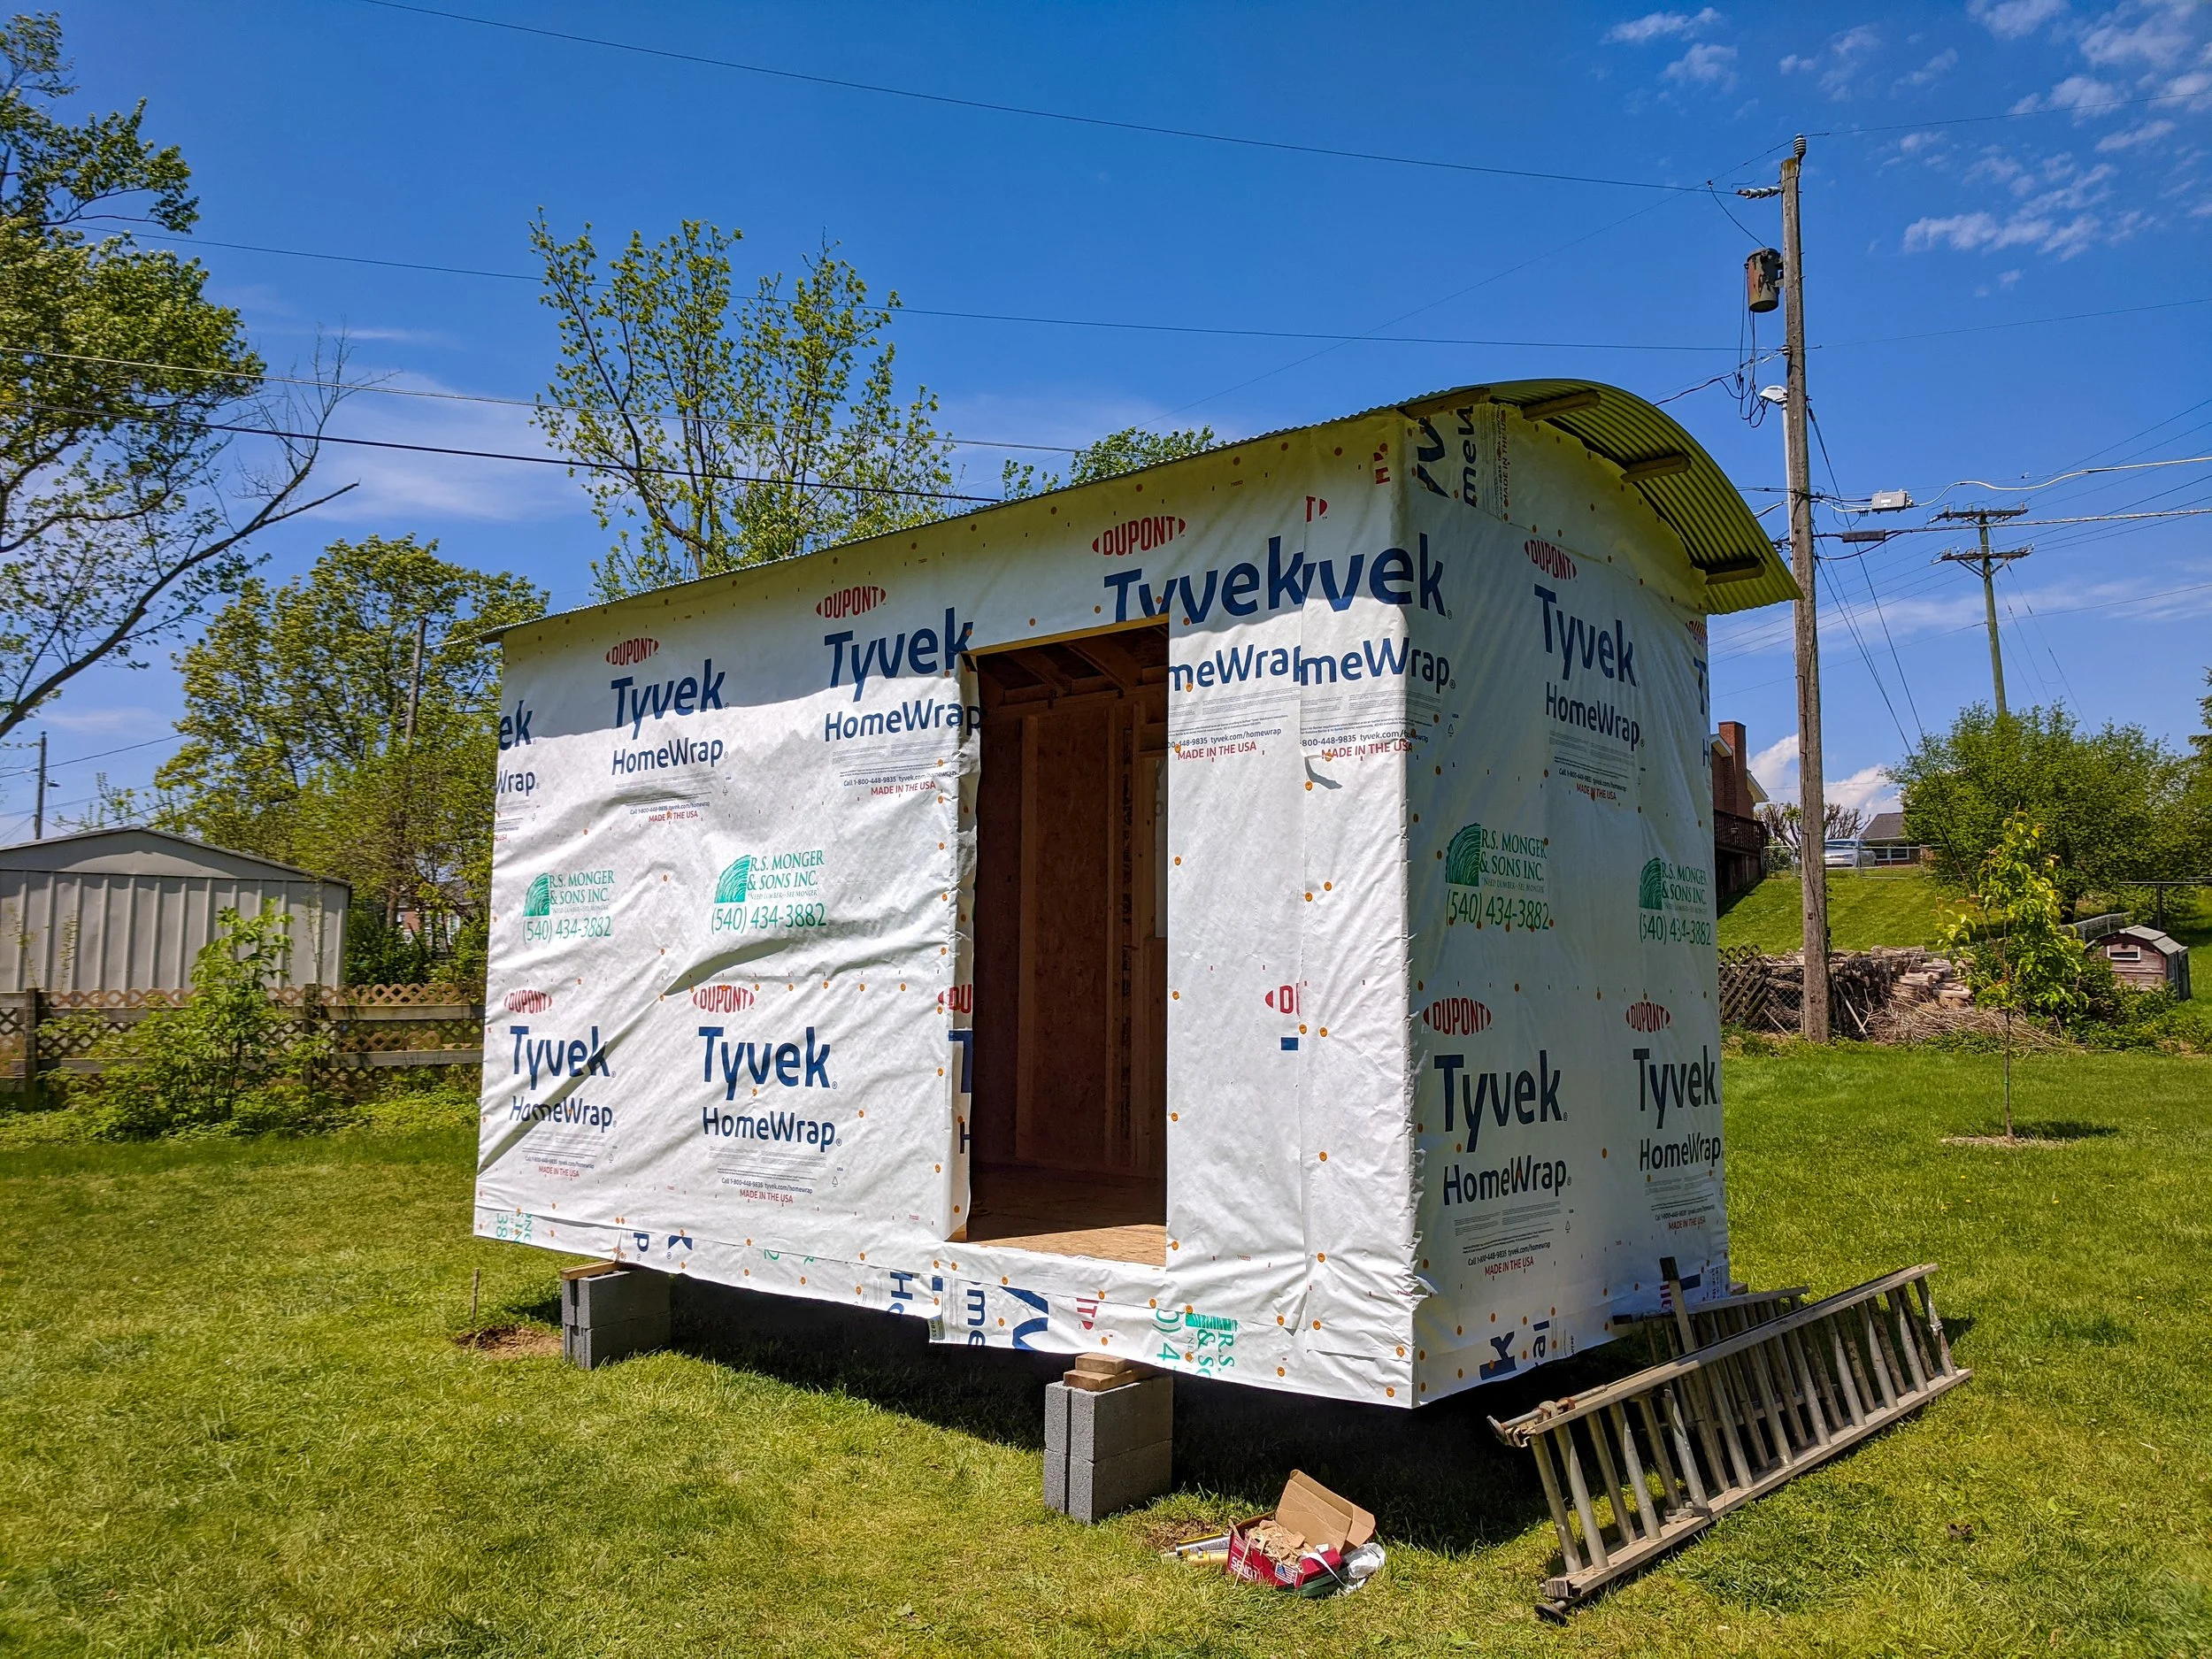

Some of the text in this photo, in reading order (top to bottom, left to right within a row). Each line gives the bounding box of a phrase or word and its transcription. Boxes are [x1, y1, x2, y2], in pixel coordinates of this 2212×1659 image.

[1102, 516, 1175, 557] DUPONT
[1530, 540, 1572, 580] DUPONT
[824, 586, 879, 618] DUPONT
[611, 637, 654, 665] DUPONT
[1533, 583, 1637, 687] Tyvek
[824, 607, 978, 702] Tyvek
[611, 658, 726, 740] Tyvek
[1693, 657, 1709, 715] T
[825, 698, 981, 741] HomeWrap
[1546, 681, 1640, 751] HomeWrap
[1178, 741, 1256, 760] MADE IN THE USA
[1210, 728, 1281, 744] tyvek.com/homewrap
[1355, 745, 1365, 756] IN
[1368, 742, 1390, 754] THE
[611, 737, 724, 775] HomeWrap
[854, 776, 896, 786] 1-800-448-9835
[871, 780, 936, 795] MADE IN THE USA
[1481, 828, 1548, 859] R.S. MONGER
[749, 849, 825, 872] R.S. MONGER
[1479, 851, 1544, 881] & SONS INC.
[1661, 862, 1675, 879] R.S.
[549, 870, 615, 888] R.S. MONGER
[747, 870, 818, 890] & SONS INC.
[1662, 880, 1670, 899] &
[1670, 883, 1692, 902] SONS
[549, 887, 610, 905] & SONS INC.
[1446, 888, 1549, 930] (540) 434-3882
[523, 915, 611, 945] (540) 434-3882
[711, 902, 827, 935] (540) 434-3882
[1640, 912, 1667, 945] (540)
[509, 989, 547, 1014] DUPONT
[700, 985, 748, 1013] DUPONT
[1432, 997, 1486, 1036] DUPONT
[1631, 1002, 1665, 1033] DUPONT
[510, 1025, 611, 1090] Tyvek
[698, 1026, 831, 1101] Tyvek
[1433, 1049, 1563, 1153] Tyvek
[1632, 1045, 1717, 1130] Tyvek
[509, 1095, 612, 1133] HomeWrap
[703, 1106, 835, 1153] HomeWrap
[1640, 1132, 1721, 1171] HomeWrap
[739, 1189, 793, 1203] MADE IN THE USA
[1443, 1155, 1567, 1206] HomeWrap
[1485, 1256, 1534, 1276] MADE IN THE USA
[1196, 1328, 1216, 1349] &
